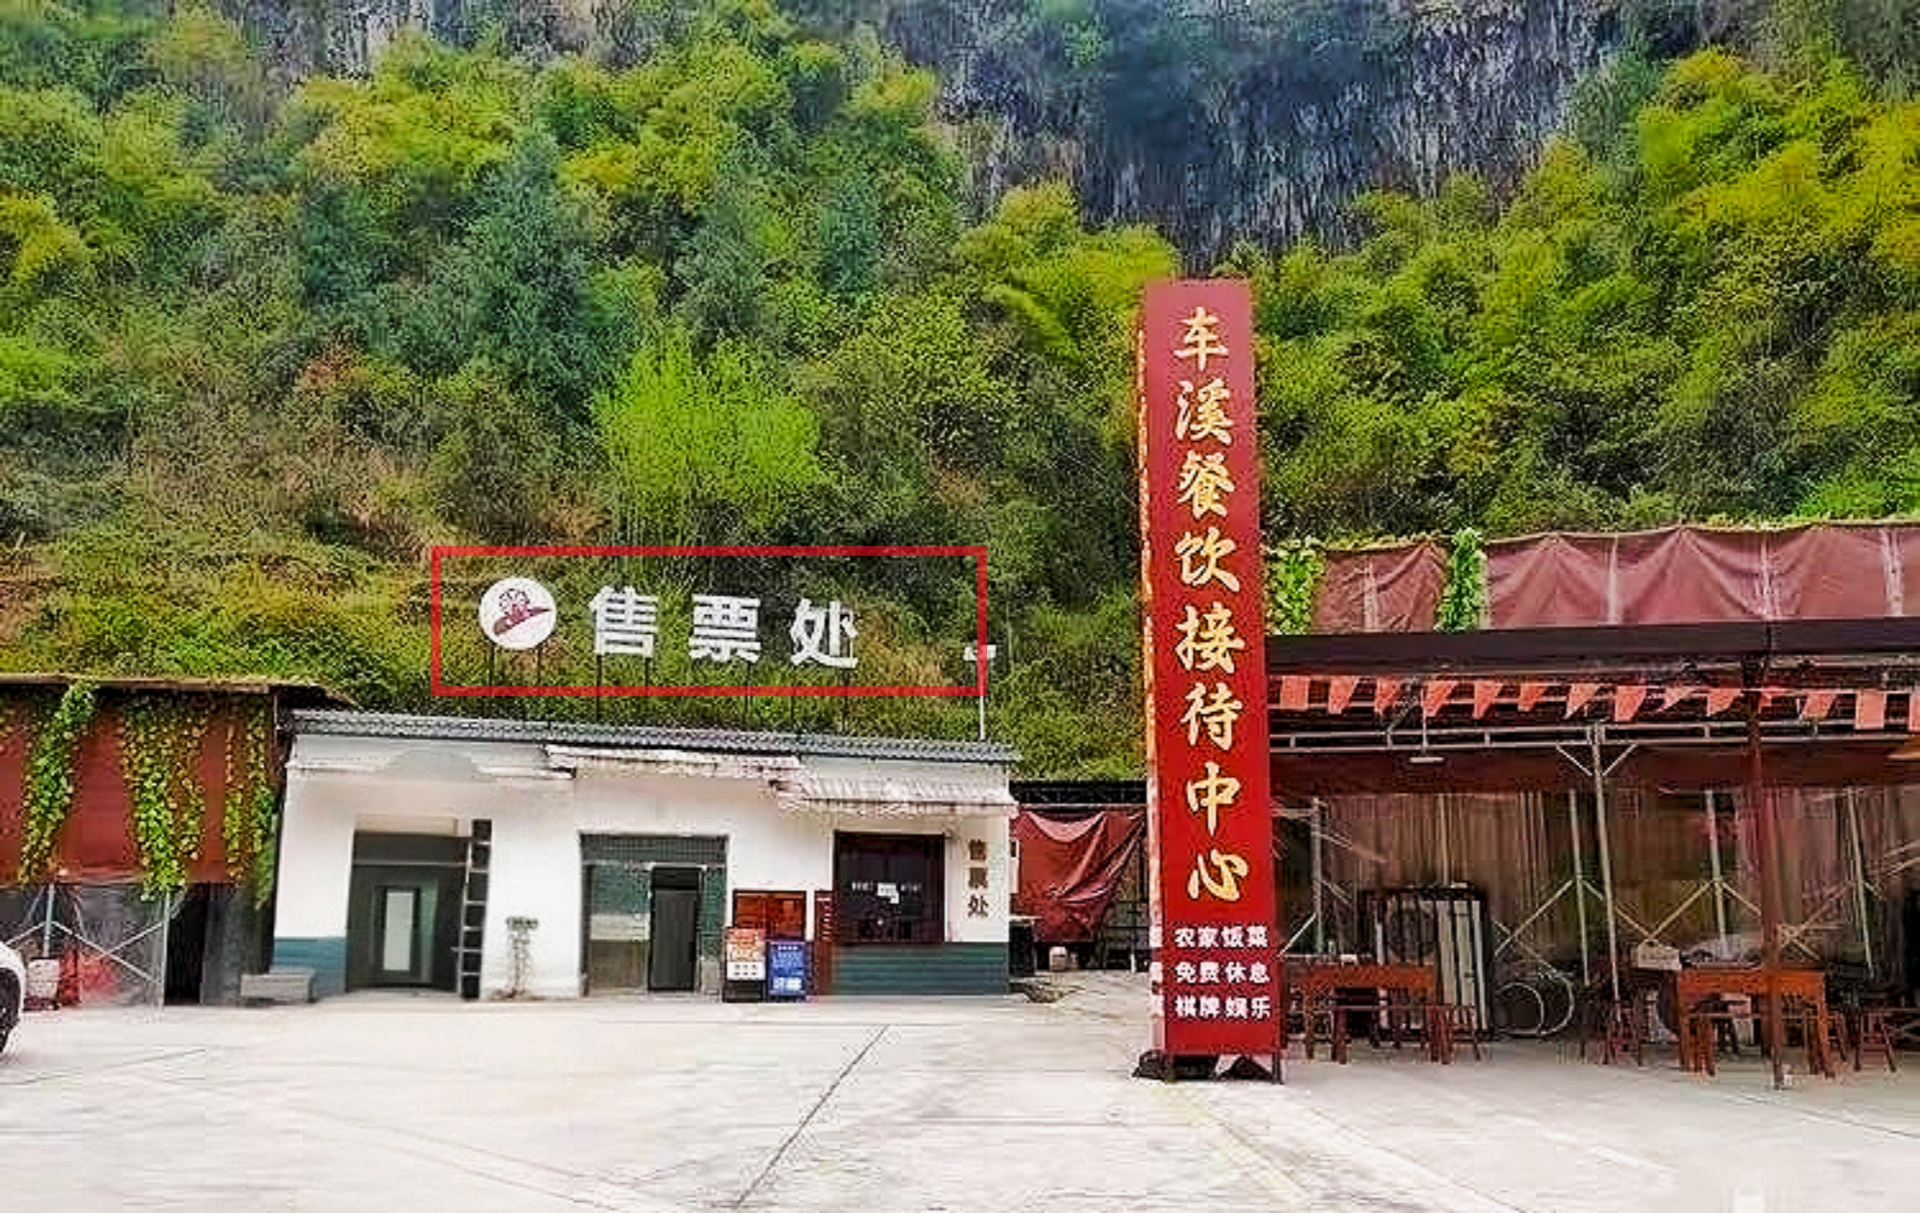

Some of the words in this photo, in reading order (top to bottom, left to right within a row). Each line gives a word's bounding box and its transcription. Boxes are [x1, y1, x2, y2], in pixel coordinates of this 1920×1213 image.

[1173, 306, 1249, 902] 车溪餐饮接待中心
[589, 585, 858, 668] 售票处
[1174, 925, 1268, 948] 农家饭菜
[1174, 961, 1271, 984] 免费休息
[1174, 995, 1272, 1020] 棋牌娱乐
